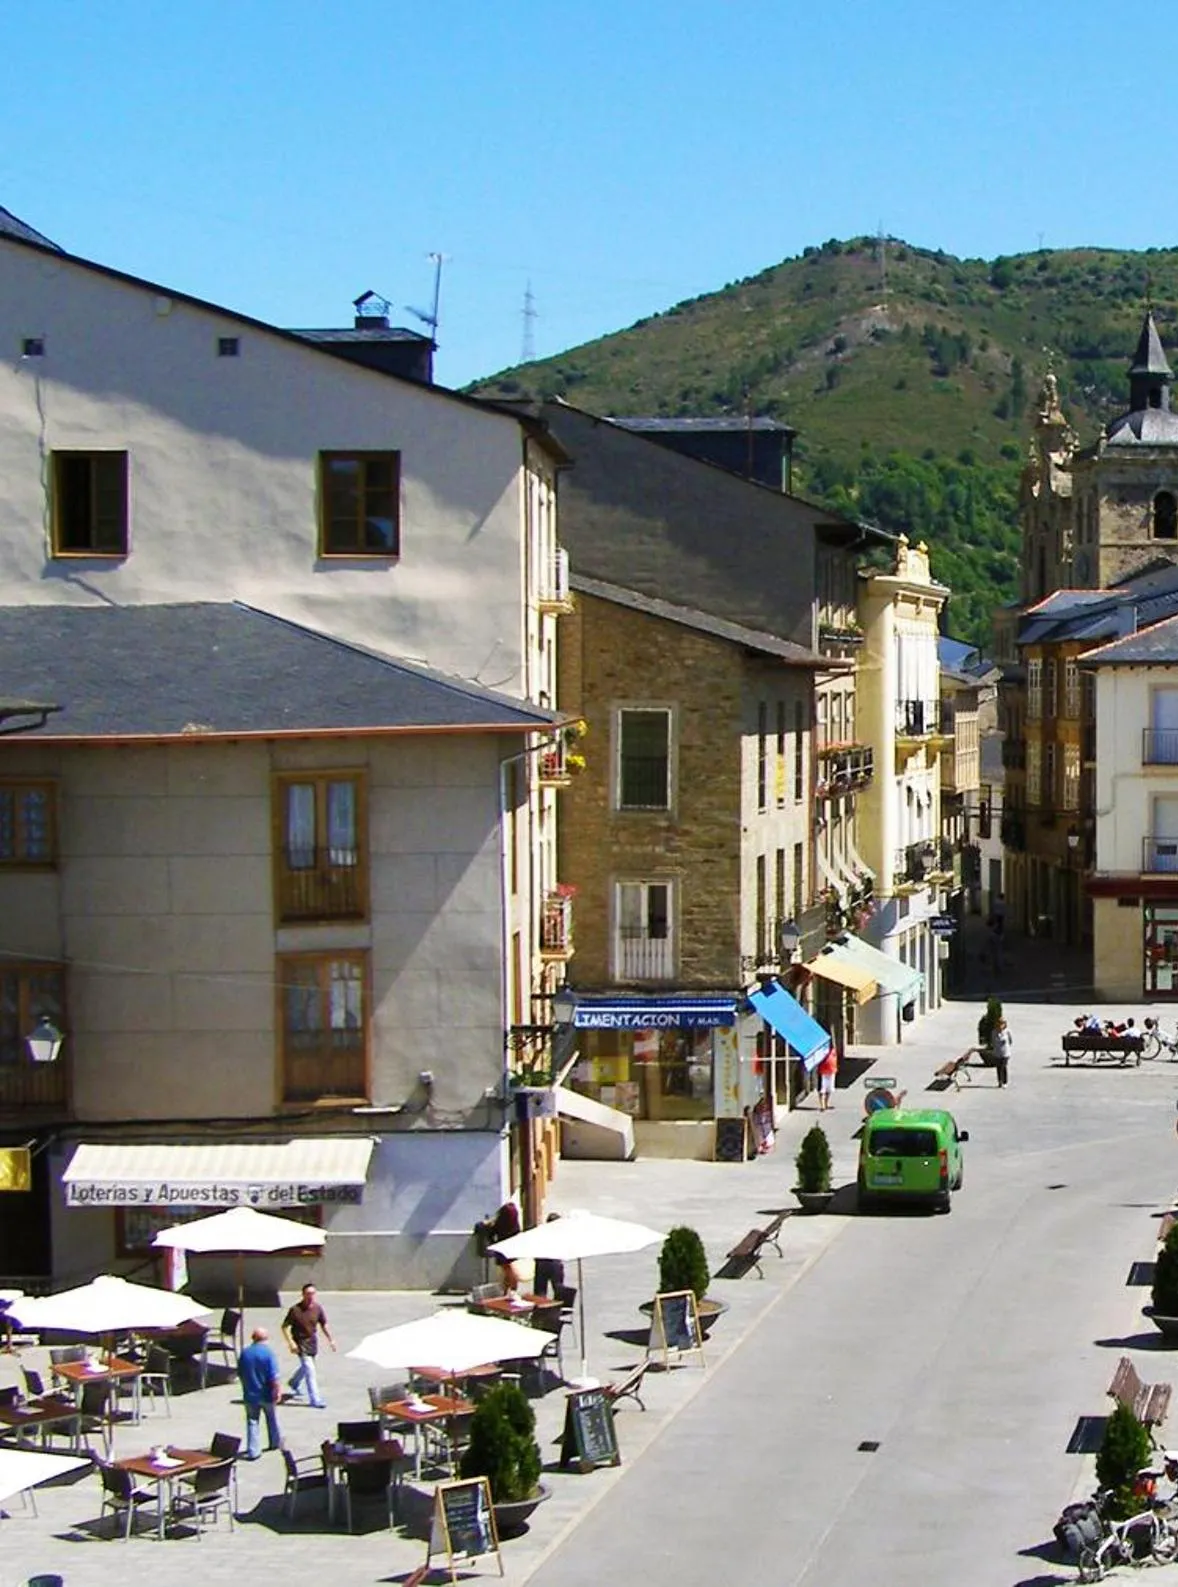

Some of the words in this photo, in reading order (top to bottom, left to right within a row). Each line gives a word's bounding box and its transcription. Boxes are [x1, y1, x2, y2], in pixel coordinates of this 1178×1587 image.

[574, 1012, 680, 1028] LIMENTACION
[71, 1184, 138, 1202] Loterías
[143, 1187, 153, 1203] y
[158, 1184, 239, 1202] Apuestas
[267, 1184, 293, 1201] del
[297, 1184, 358, 1202] Estado
